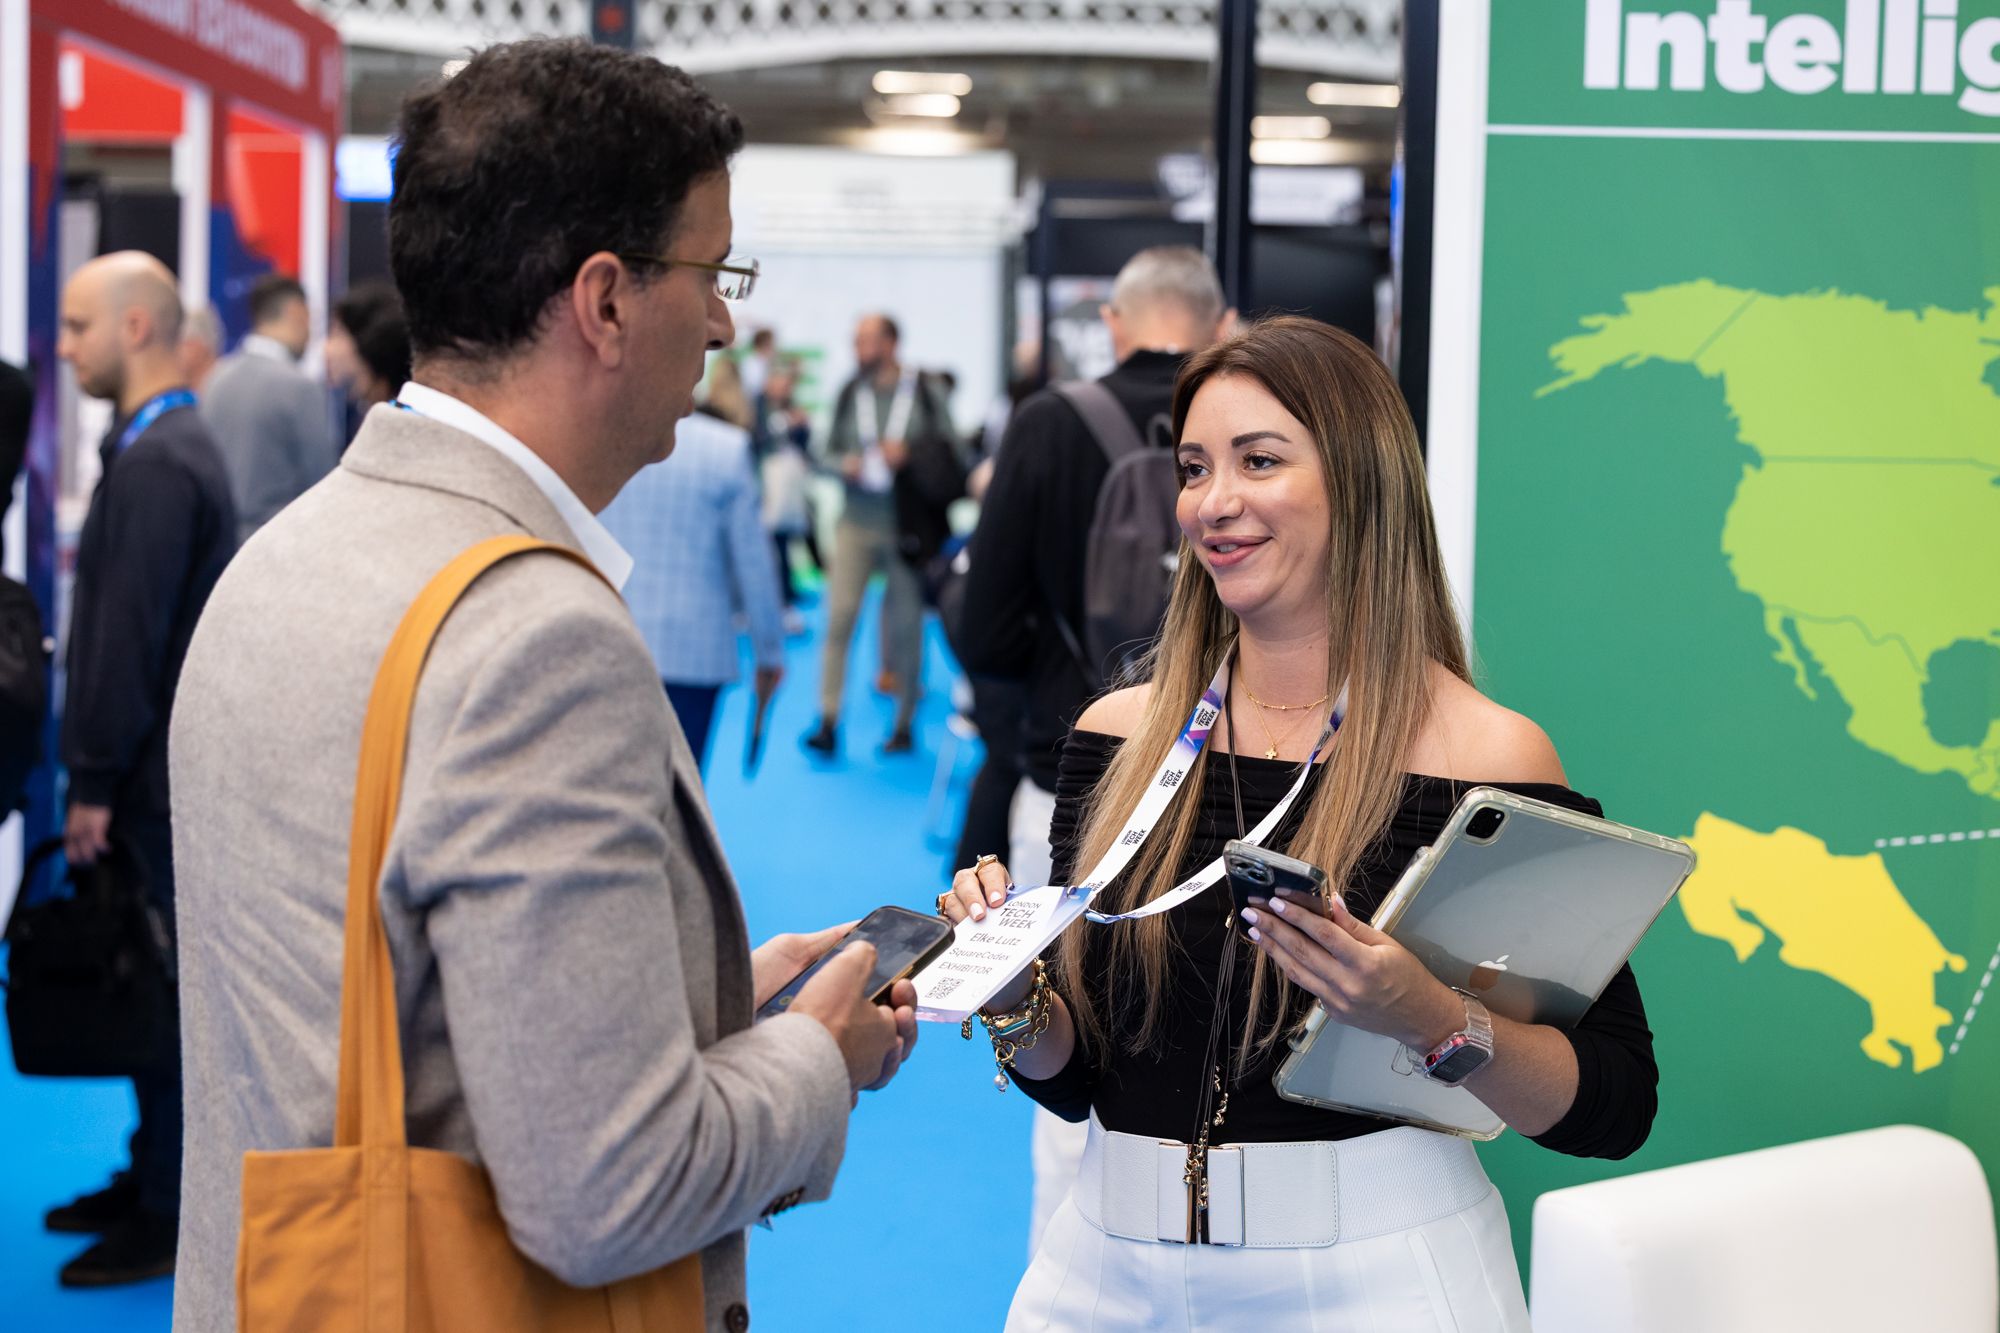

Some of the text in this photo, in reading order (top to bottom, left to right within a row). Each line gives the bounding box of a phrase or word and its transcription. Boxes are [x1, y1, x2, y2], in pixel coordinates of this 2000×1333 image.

[1163, 771, 1175, 788] TECH
[1171, 769, 1184, 787] WEEK
[1125, 831, 1138, 846] TECH
[1133, 829, 1147, 845] WEEK
[1008, 901, 1042, 910] LONDON
[1000, 907, 1034, 919] TECH
[998, 918, 1037, 930] WEEK
[969, 932, 1022, 946] Elke Lutz
[949, 947, 1010, 961] SquareCodex
[938, 961, 993, 975] EXHIBITOR
